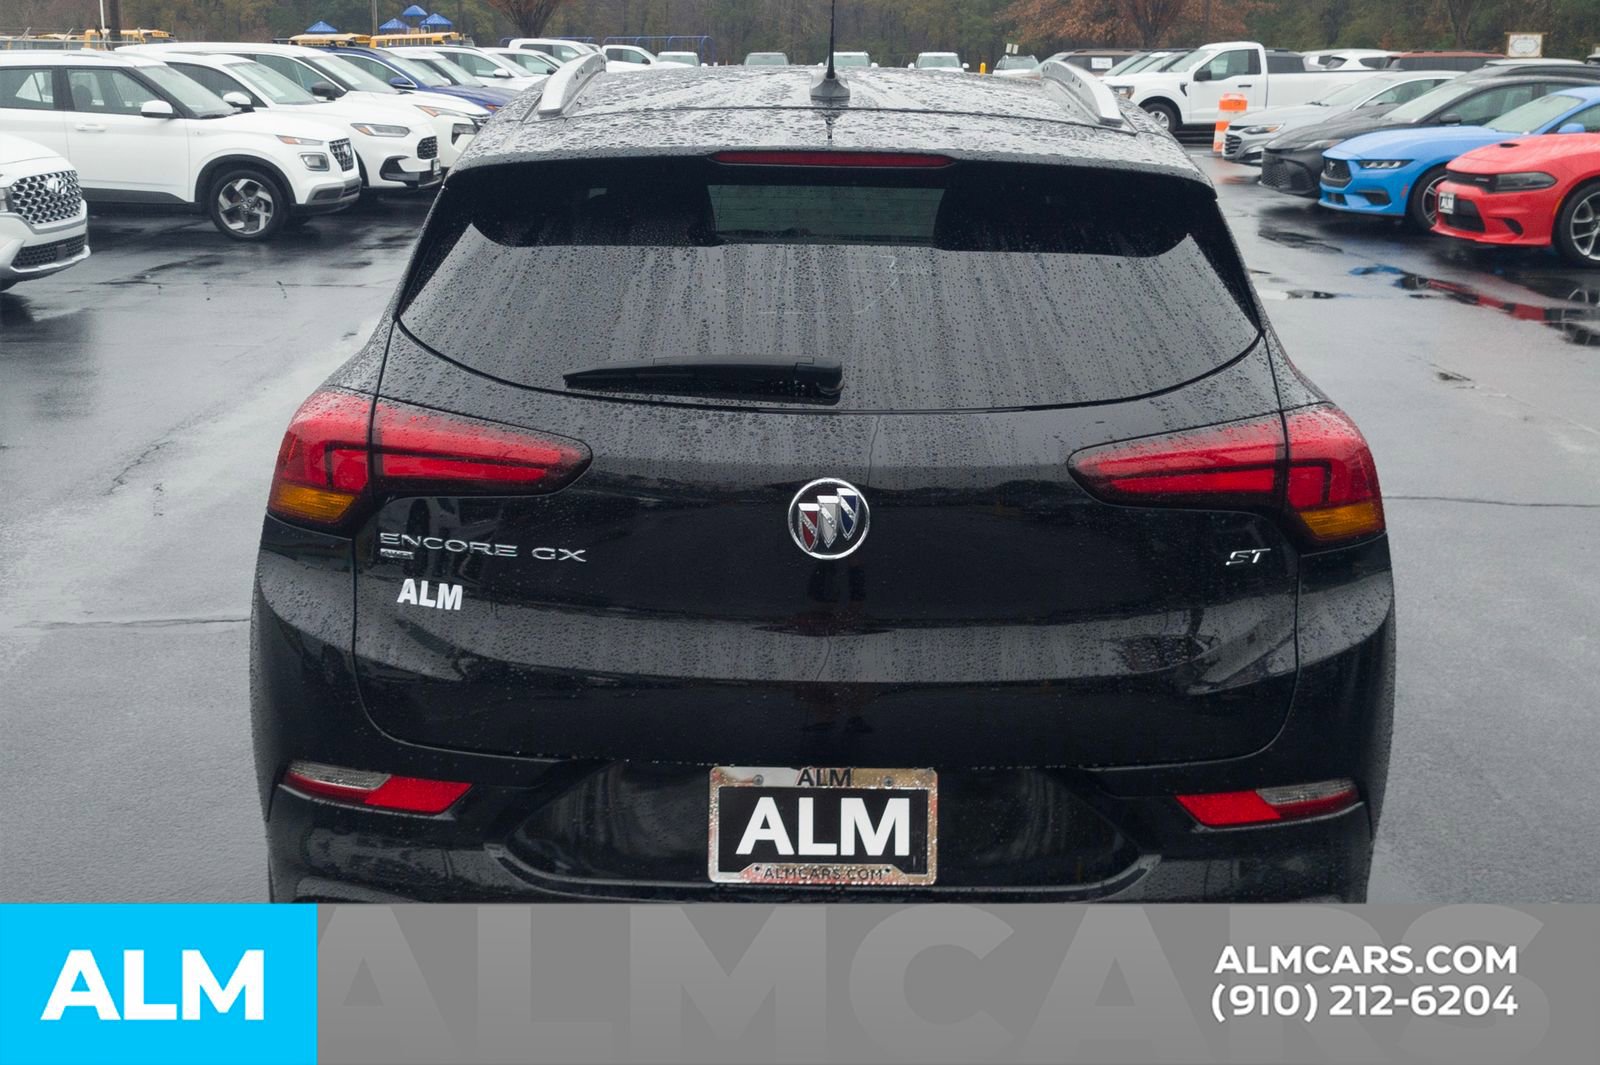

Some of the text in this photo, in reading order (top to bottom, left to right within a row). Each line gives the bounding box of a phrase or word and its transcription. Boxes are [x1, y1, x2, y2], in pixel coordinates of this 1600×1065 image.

[380, 532, 587, 562] ENCORE GX
[1226, 548, 1270, 564] ST
[396, 578, 463, 611] ALM
[797, 768, 851, 787] ALM
[736, 797, 910, 856] ALM
[763, 867, 883, 881] ALMCARS.COM
